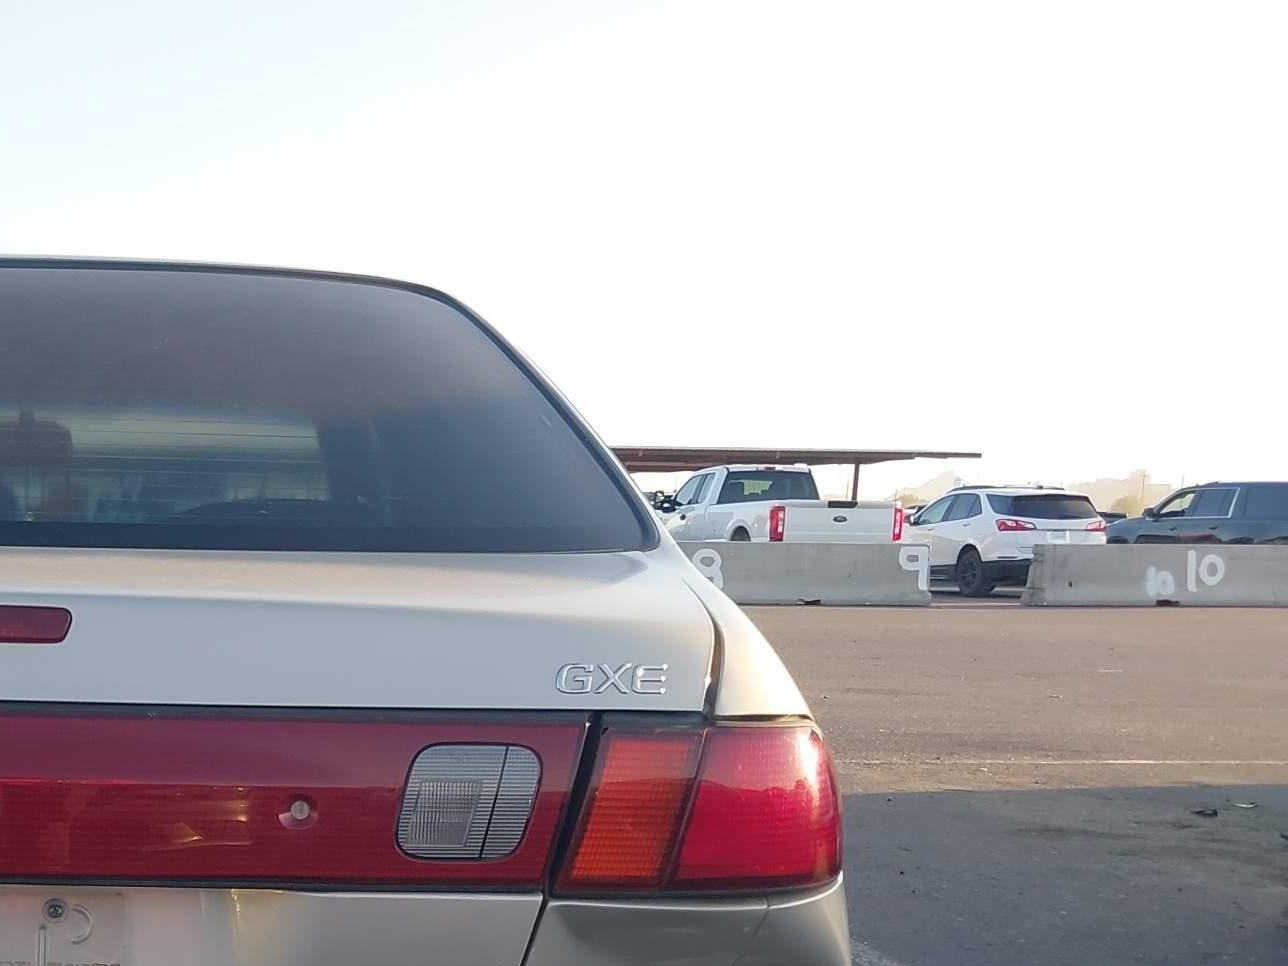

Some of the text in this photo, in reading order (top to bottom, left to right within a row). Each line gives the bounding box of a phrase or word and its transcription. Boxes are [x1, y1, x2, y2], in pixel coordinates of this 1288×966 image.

[899, 547, 929, 590] 9
[1187, 550, 1224, 592] 10
[556, 662, 667, 694] GXE
